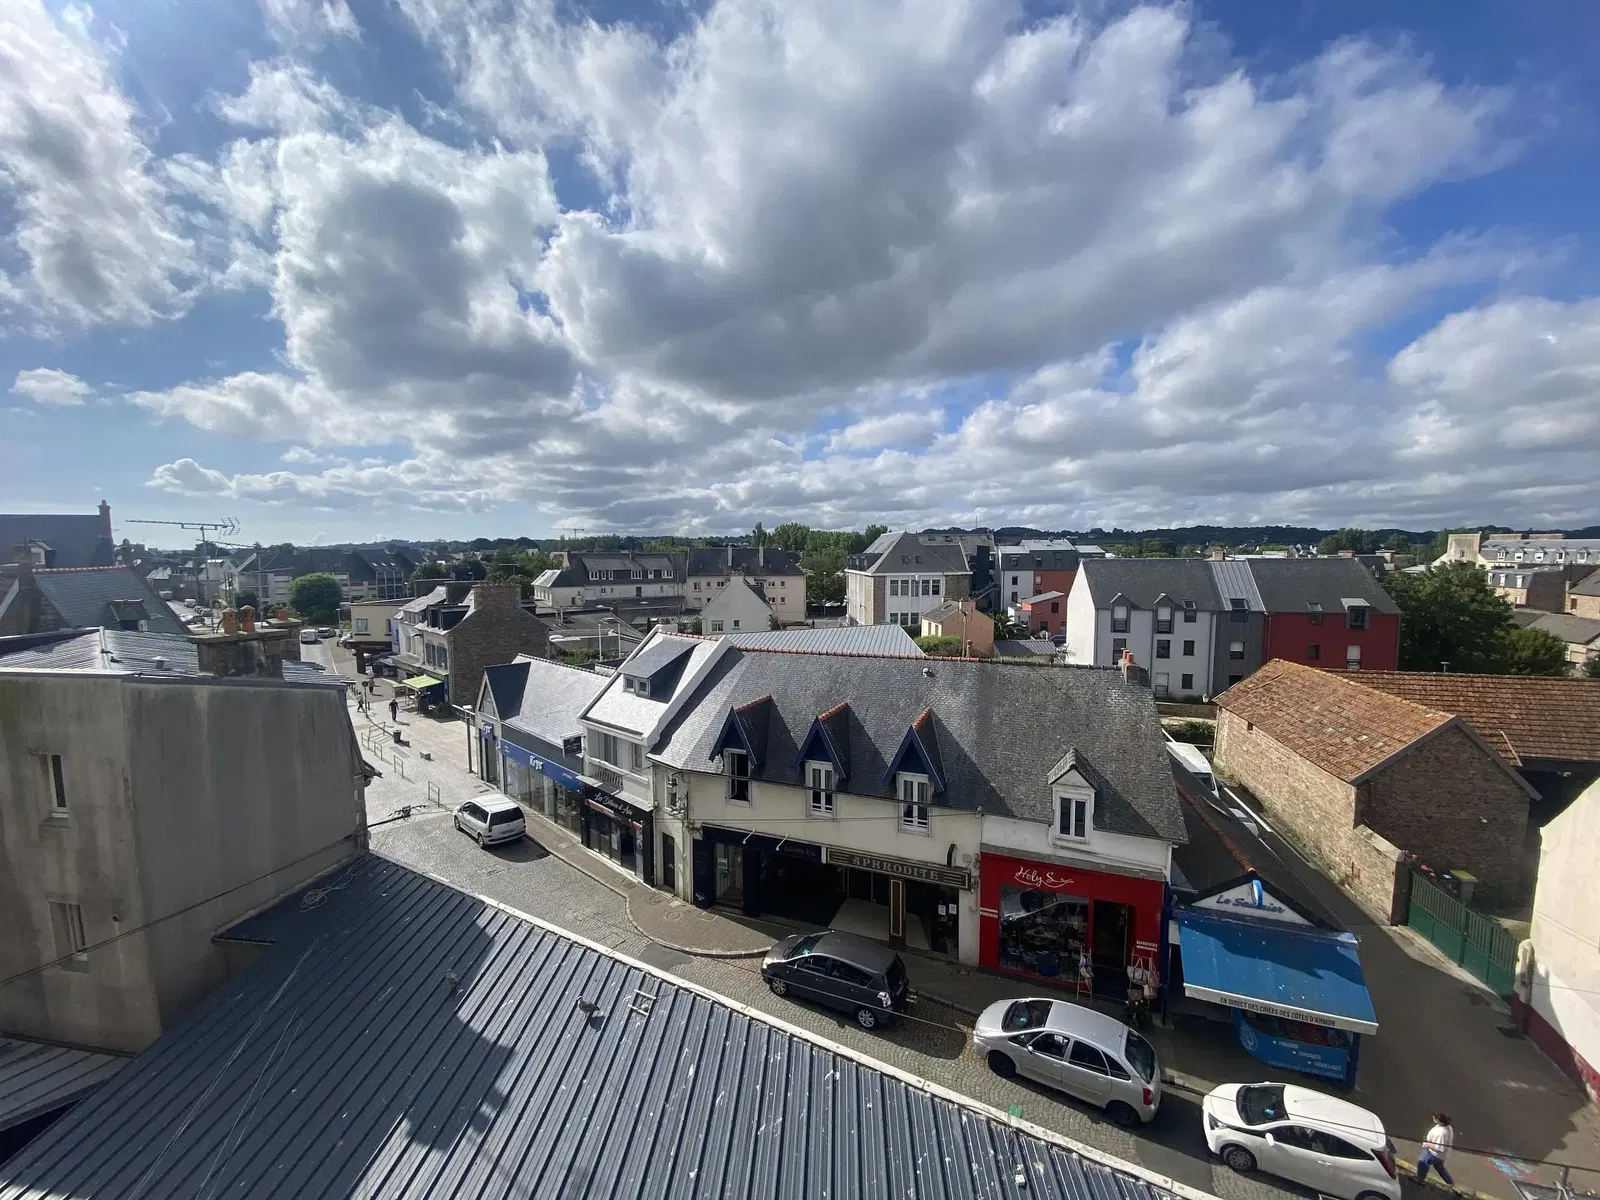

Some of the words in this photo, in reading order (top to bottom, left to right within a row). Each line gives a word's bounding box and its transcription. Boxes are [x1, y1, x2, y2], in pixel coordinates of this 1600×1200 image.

[851, 856, 939, 880] APHRODITE
[1015, 866, 1042, 887] Holy
[1228, 998, 1247, 1008] DIRECT
